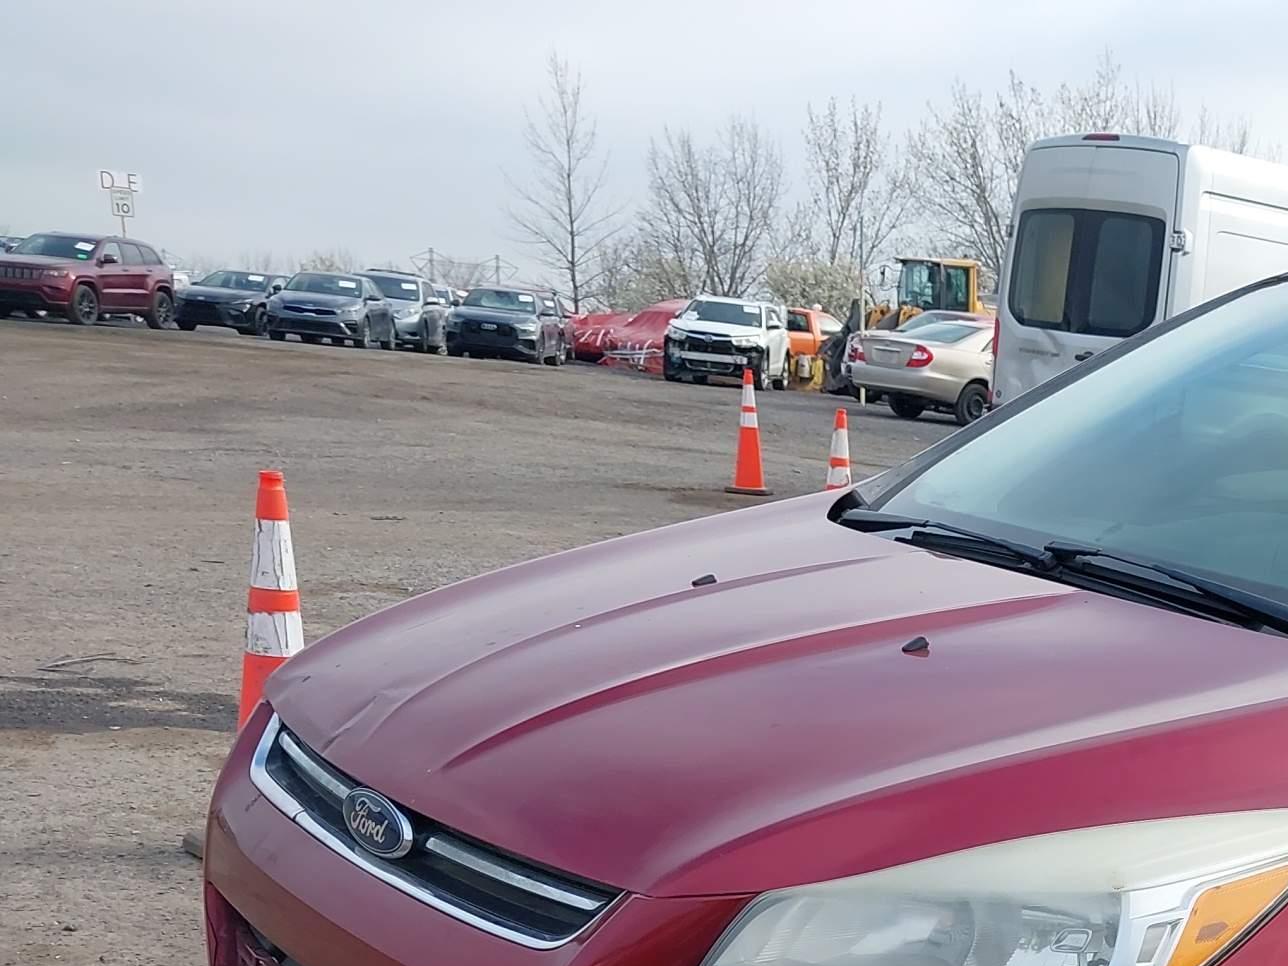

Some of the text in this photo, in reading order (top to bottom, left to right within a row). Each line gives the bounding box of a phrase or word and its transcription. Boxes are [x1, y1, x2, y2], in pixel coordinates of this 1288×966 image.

[100, 170, 139, 193] D E
[115, 202, 131, 214] 10
[350, 797, 389, 844] Ford
